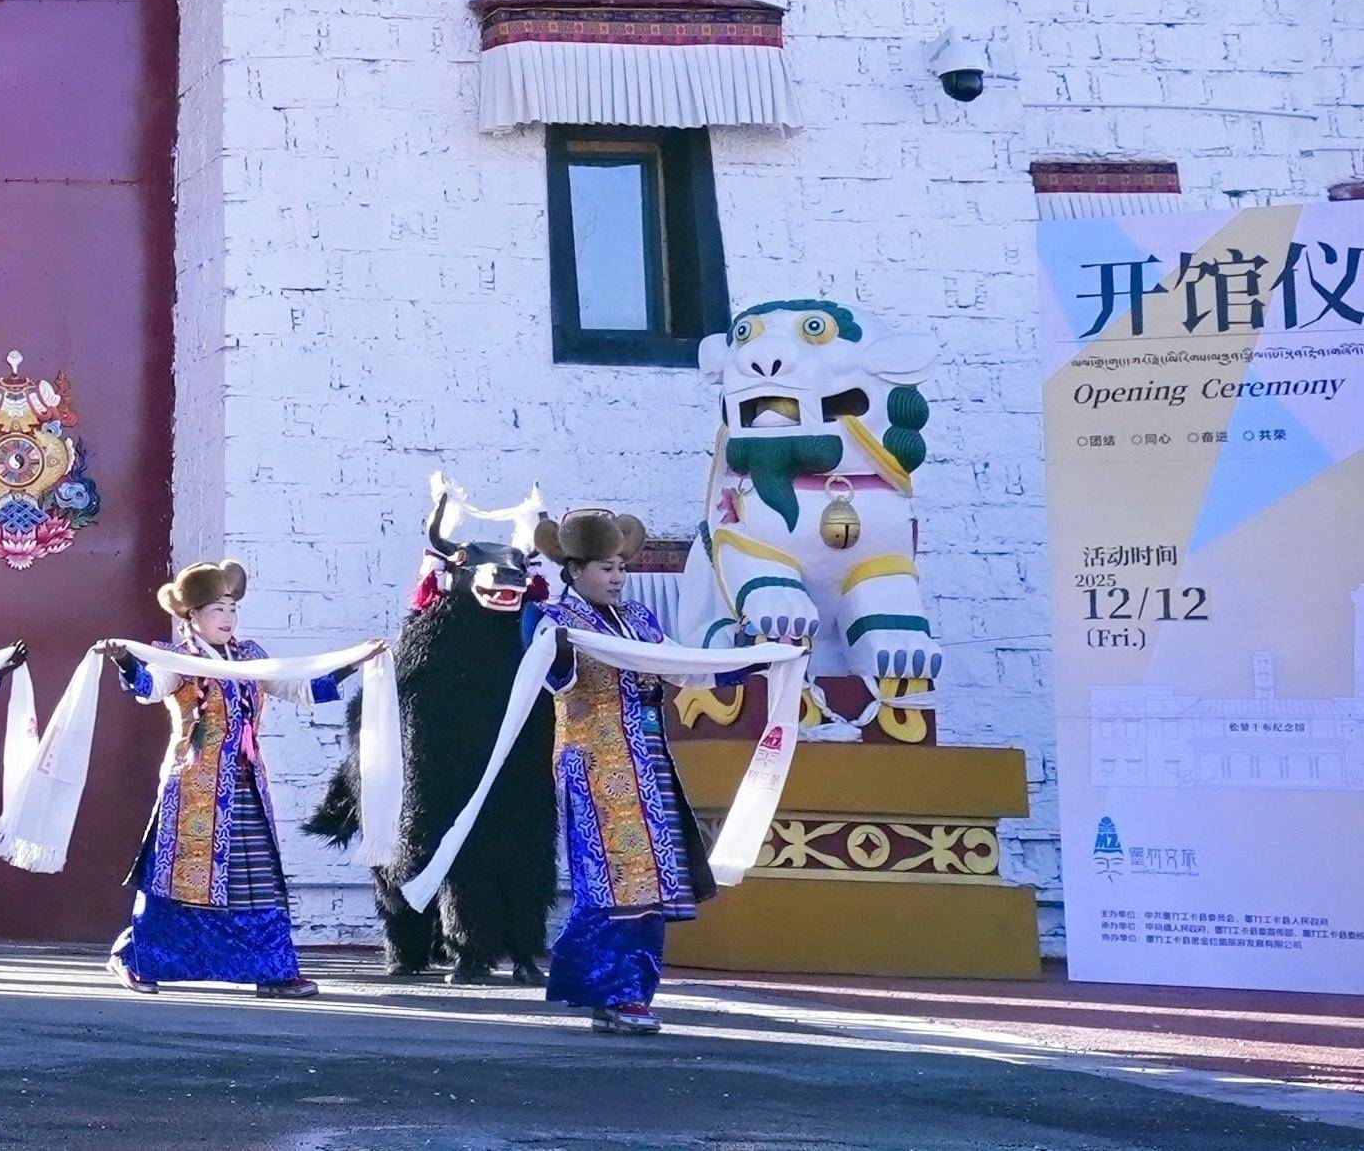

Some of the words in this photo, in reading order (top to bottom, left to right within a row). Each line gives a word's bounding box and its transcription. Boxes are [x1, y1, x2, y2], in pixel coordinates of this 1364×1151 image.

[1073, 380, 1190, 409] Opening
[1201, 376, 1347, 401] Ceremony
[1090, 435, 1116, 447] 团结
[1145, 433, 1172, 445] 同心
[1201, 430, 1229, 443] 奋进
[1258, 429, 1287, 442] 共荣
[1083, 545, 1178, 568] 活动时间
[1075, 574, 1117, 588] 2025
[1083, 587, 1209, 621] 12/12
[1087, 627, 1146, 650] (Fri.)
